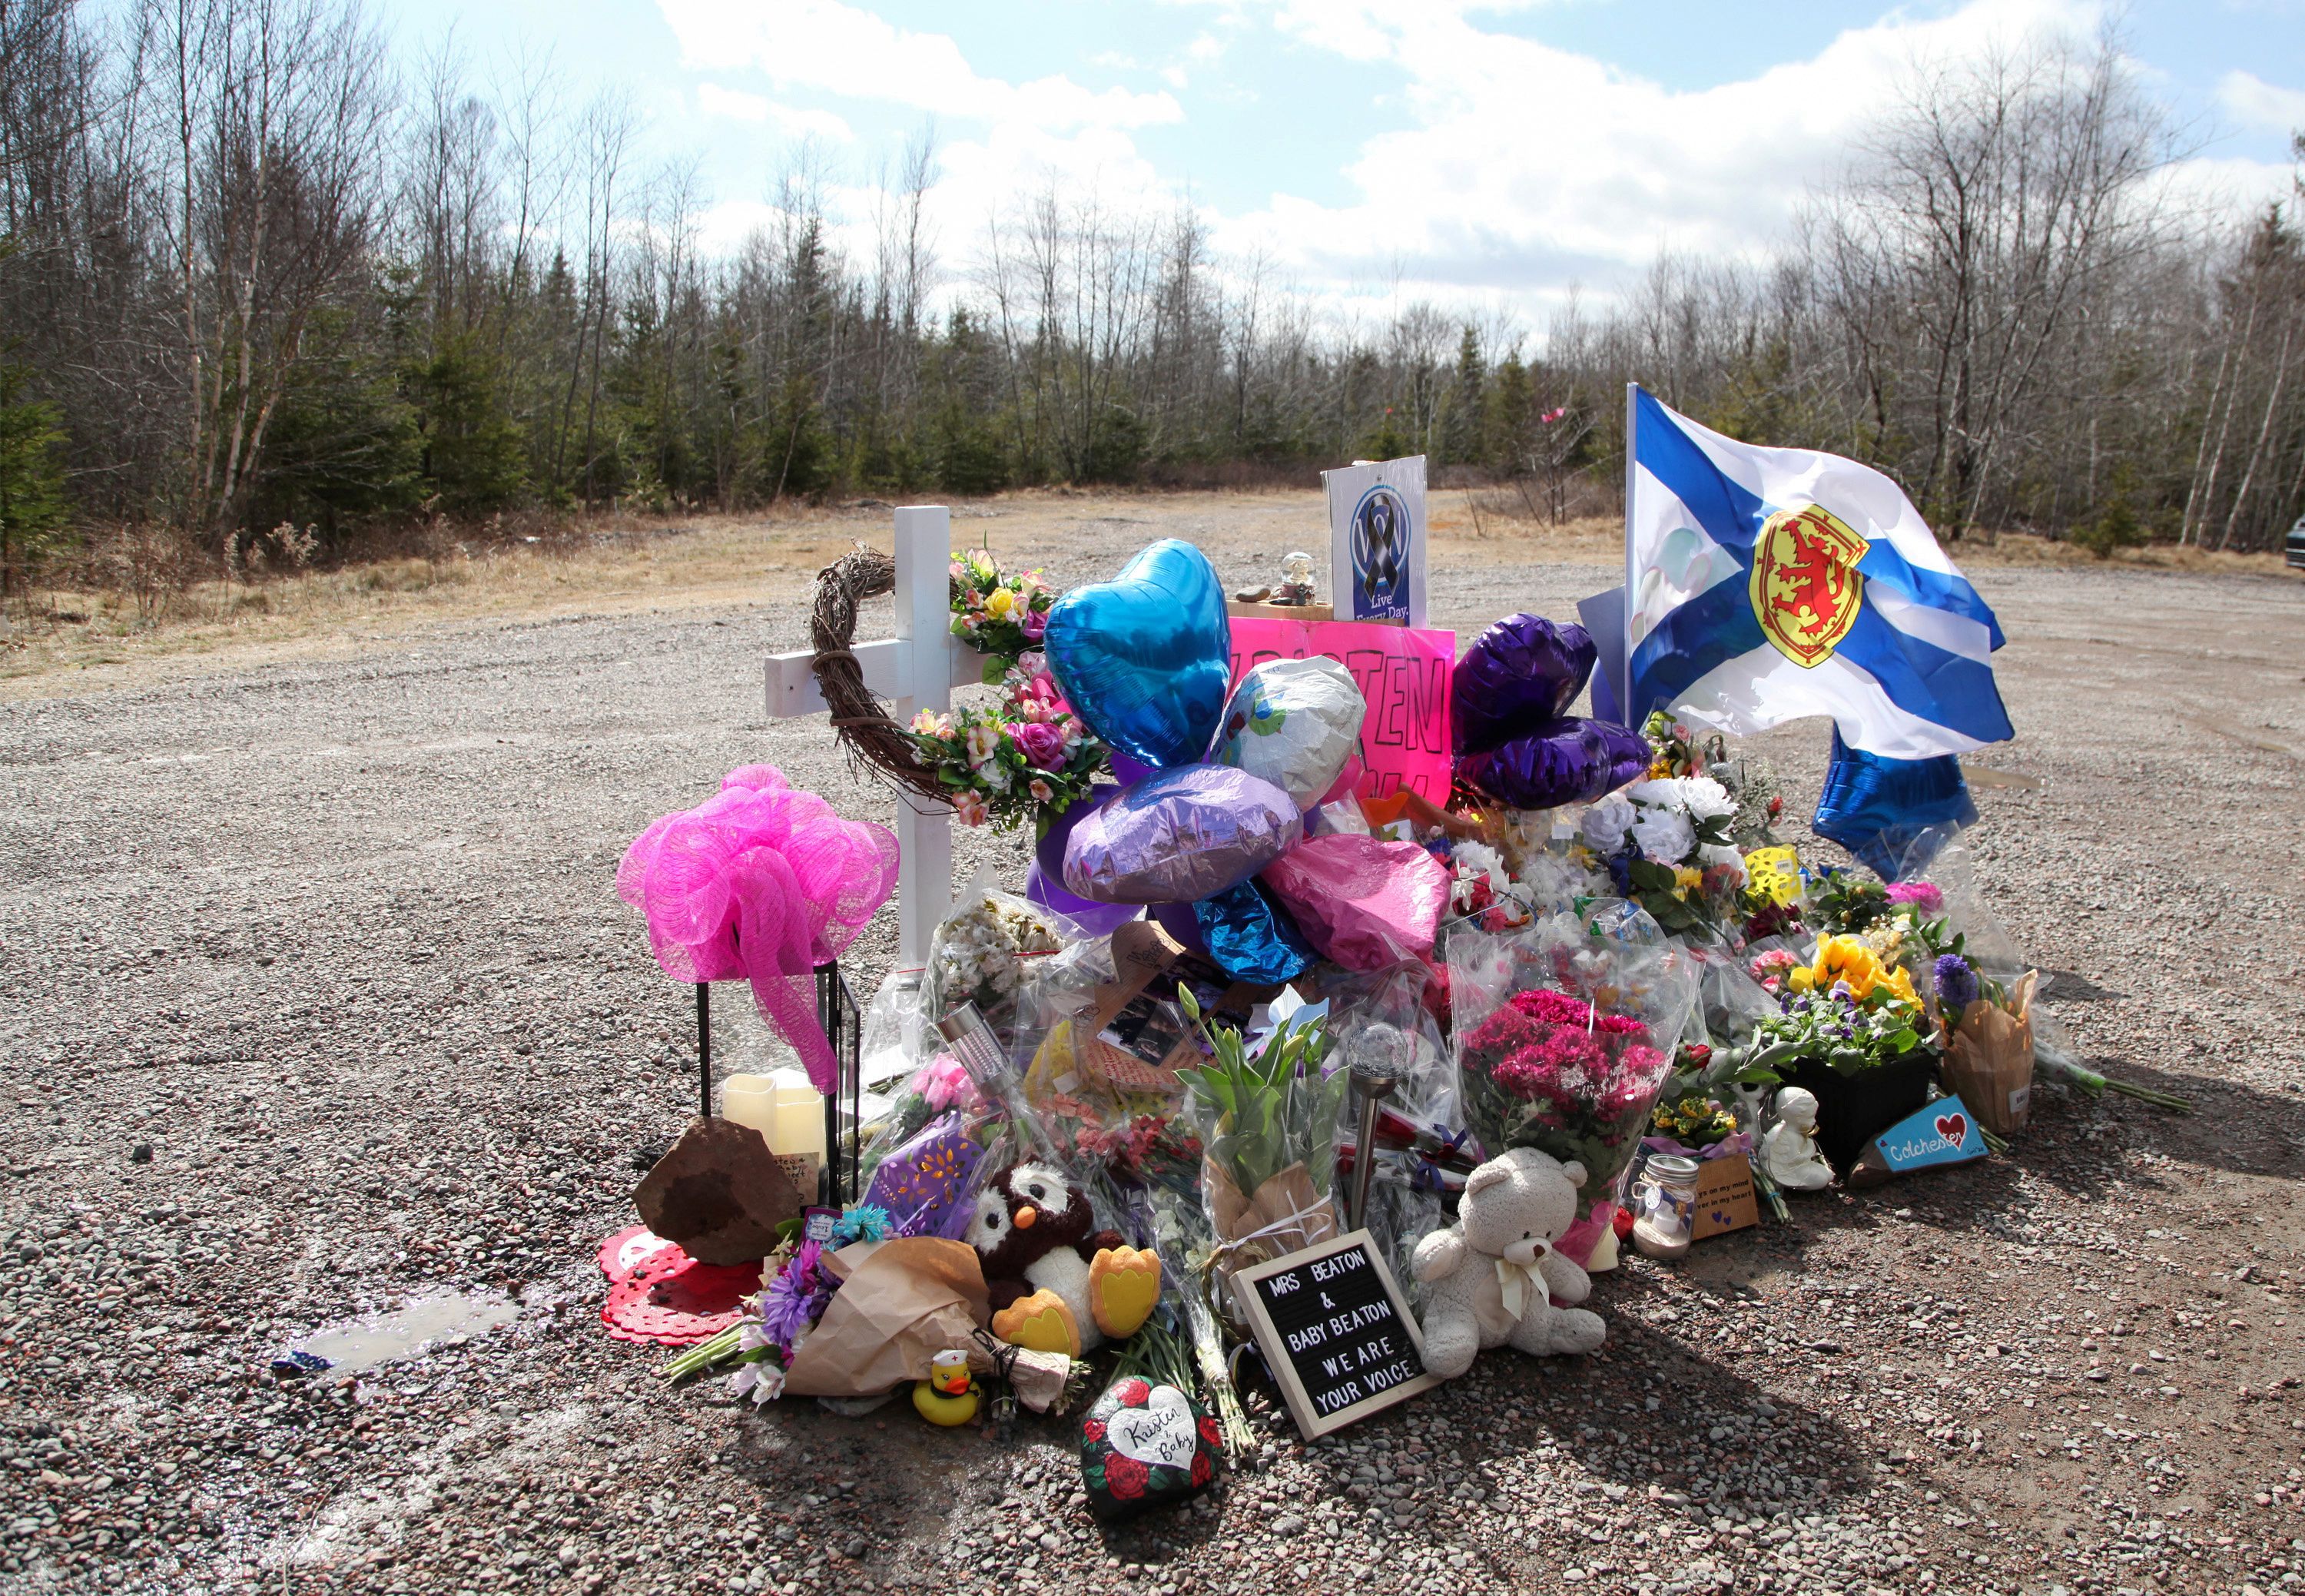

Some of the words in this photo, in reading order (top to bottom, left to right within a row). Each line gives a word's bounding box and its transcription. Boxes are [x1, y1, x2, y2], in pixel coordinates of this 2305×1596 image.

[1371, 594, 1392, 609] Live
[1388, 606, 1409, 620] Day.
[1890, 1131, 1966, 1162] Colchester
[1720, 1185, 1730, 1194] my
[1733, 1179, 1749, 1190] mind
[1720, 1197, 1730, 1207] my
[1732, 1191, 1751, 1202] heart
[1269, 1272, 1300, 1297] MRS
[1311, 1249, 1365, 1282] BEATON
[1320, 1292, 1335, 1309] &
[1288, 1322, 1327, 1352] BABY
[1330, 1299, 1391, 1336] BEATON
[1322, 1352, 1354, 1378] WE
[1358, 1337, 1395, 1366] ARE
[1316, 1381, 1361, 1413] YOUR
[1363, 1359, 1415, 1393] VOICE
[1123, 1408, 1181, 1448] Kristen
[1155, 1432, 1194, 1462] Baby
